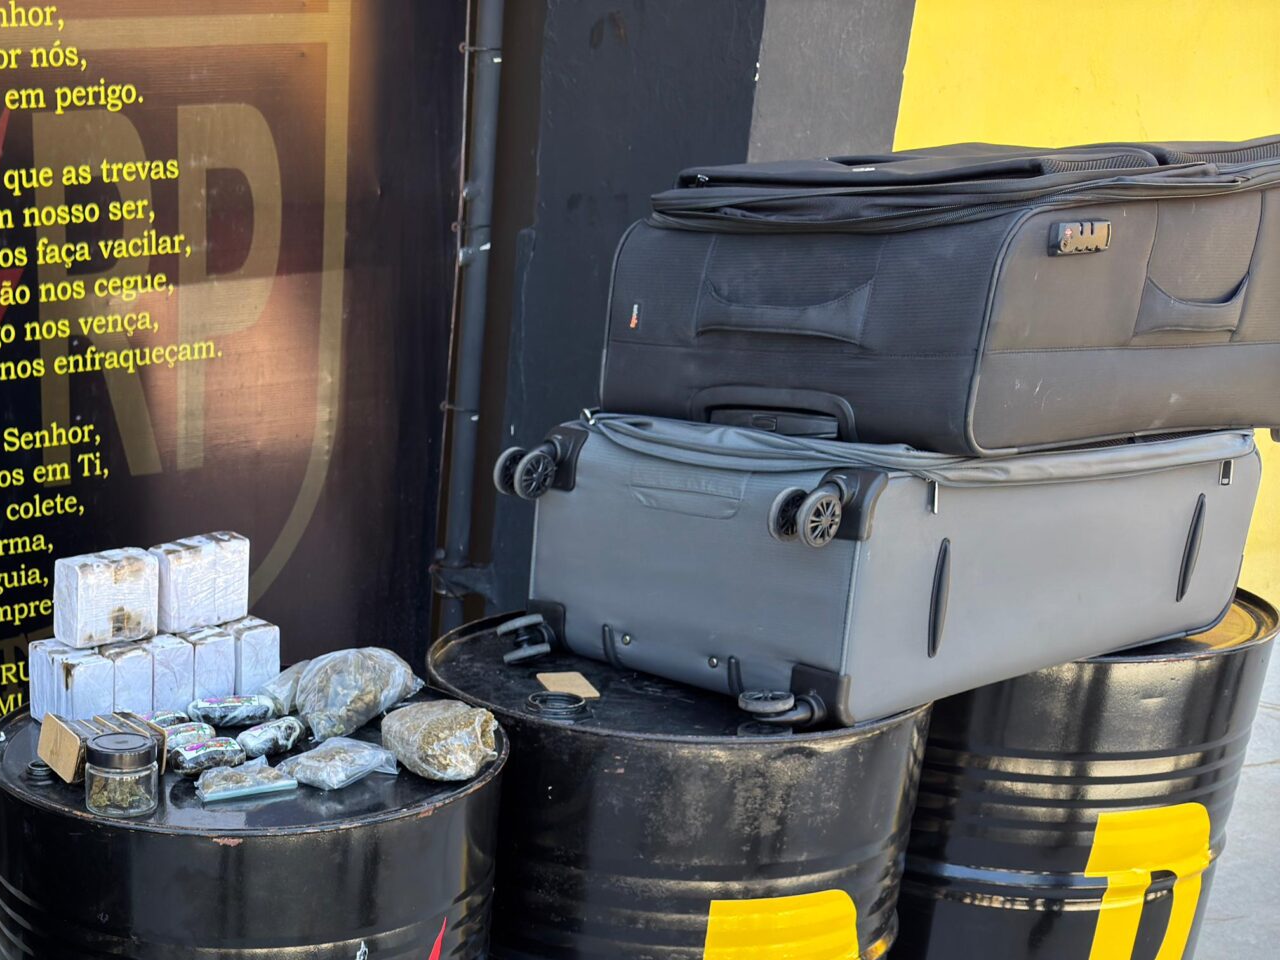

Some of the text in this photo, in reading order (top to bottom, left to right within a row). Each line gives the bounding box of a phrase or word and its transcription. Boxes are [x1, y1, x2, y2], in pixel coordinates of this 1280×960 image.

[31, 39, 88, 70] nós,
[5, 88, 47, 110] em
[55, 79, 145, 115] perigo.
[4, 167, 53, 196] que
[61, 164, 92, 186] as
[101, 159, 180, 183] trevas
[23, 203, 100, 227] nosso
[109, 199, 156, 223] ser,
[37, 237, 91, 269] faça
[99, 230, 192, 259] vacilar,
[39, 280, 86, 303] nos
[94, 274, 175, 303] cegue,
[25, 319, 71, 341] nos
[78, 312, 160, 336] vença,
[0, 359, 46, 381] nos
[53, 342, 223, 375] enfraqueçam.
[3, 422, 101, 452] Senhor,
[33, 463, 71, 483] em
[77, 453, 109, 477] Ti,
[6, 495, 85, 521] colete,
